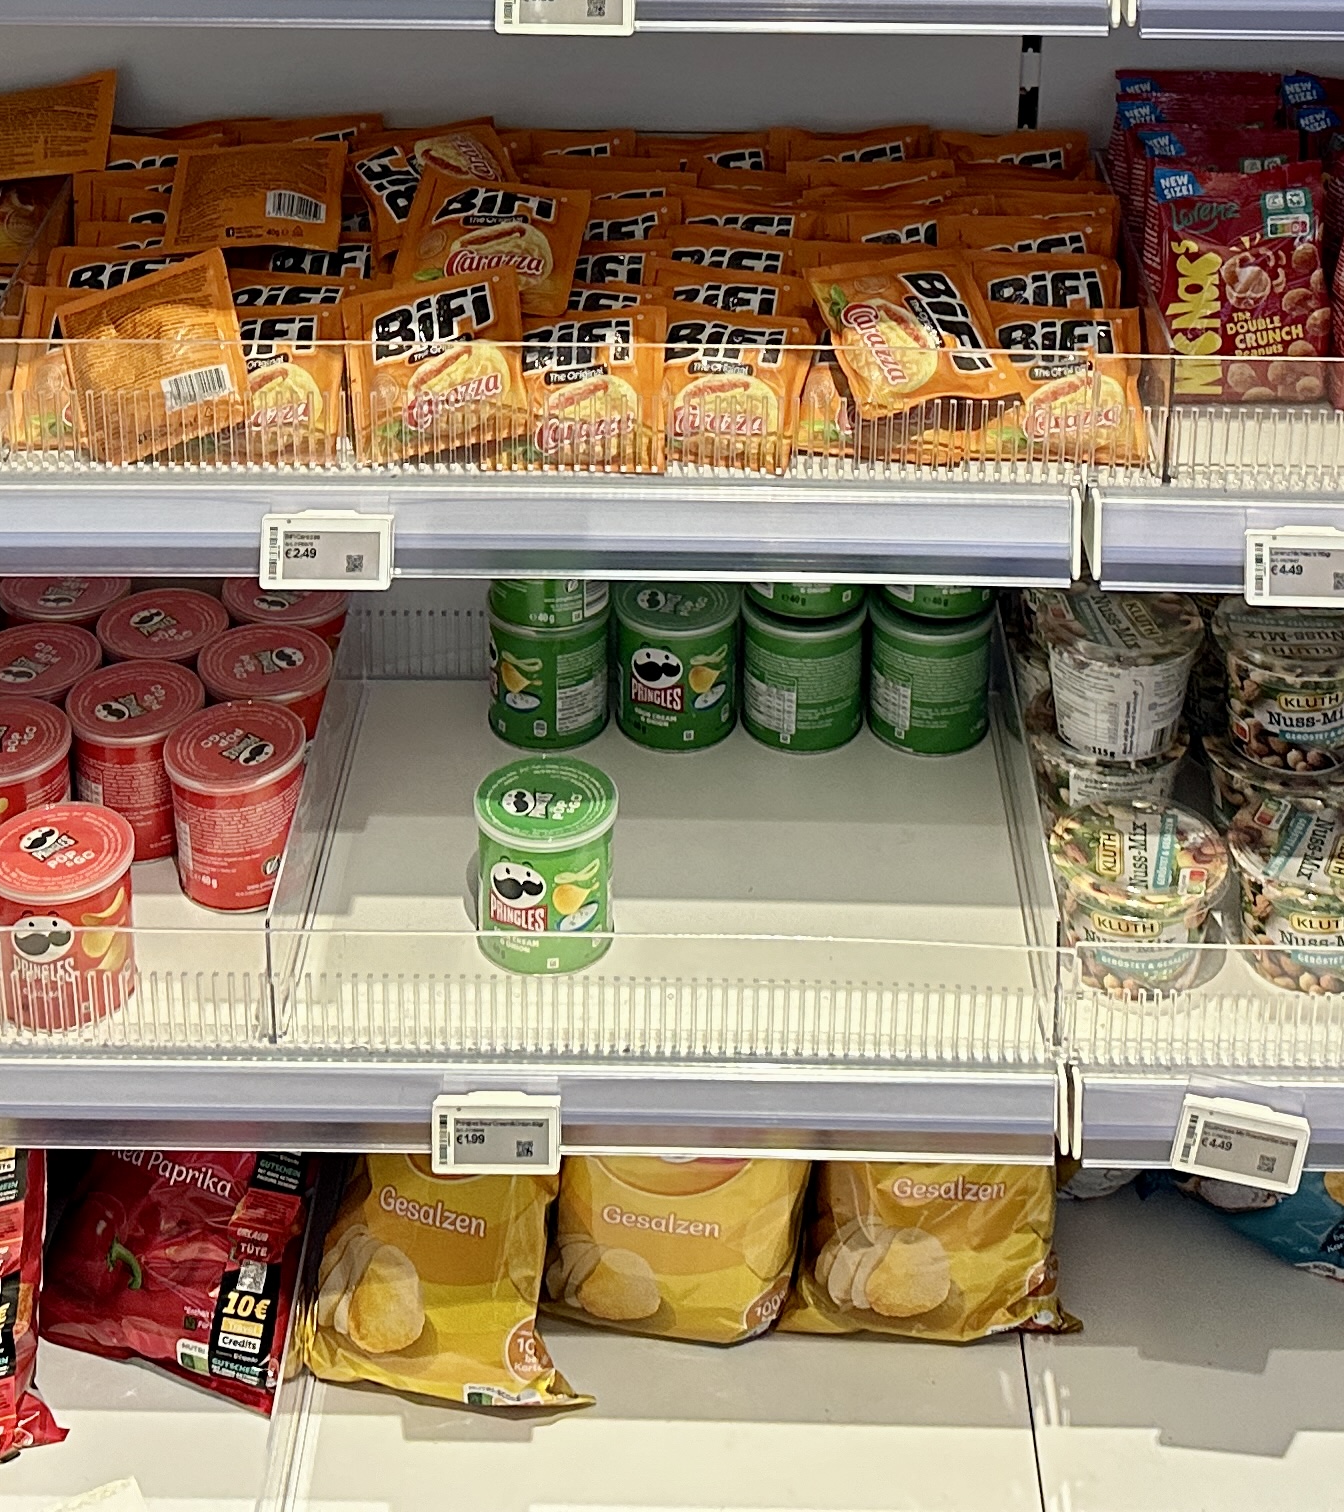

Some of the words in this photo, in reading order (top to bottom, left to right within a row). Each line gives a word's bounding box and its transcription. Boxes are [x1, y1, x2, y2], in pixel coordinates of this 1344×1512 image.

[1160, 176, 1188, 189] NEW
[1162, 185, 1193, 198] SIZE!
[1226, 317, 1281, 335] DOUBLE
[1235, 325, 1303, 349] CRUNCH
[1126, 602, 1157, 635] KLUTH
[631, 680, 682, 711] PRINGLES
[1284, 693, 1340, 708] KLUTH
[1101, 833, 1118, 873] KLUTH
[1128, 822, 1148, 889] Nuss-Mix
[1297, 817, 1335, 880] Nuss-Mix
[491, 895, 545, 931] PRINGLES
[1096, 918, 1156, 933] KLUTH
[147, 1154, 232, 1198] Paprika
[891, 1177, 1006, 1203] Gesalzen
[378, 1184, 487, 1239] Gesalzen
[601, 1205, 720, 1239] Gesalzen
[224, 1293, 270, 1318] 10€
[221, 1335, 258, 1350] Credits
